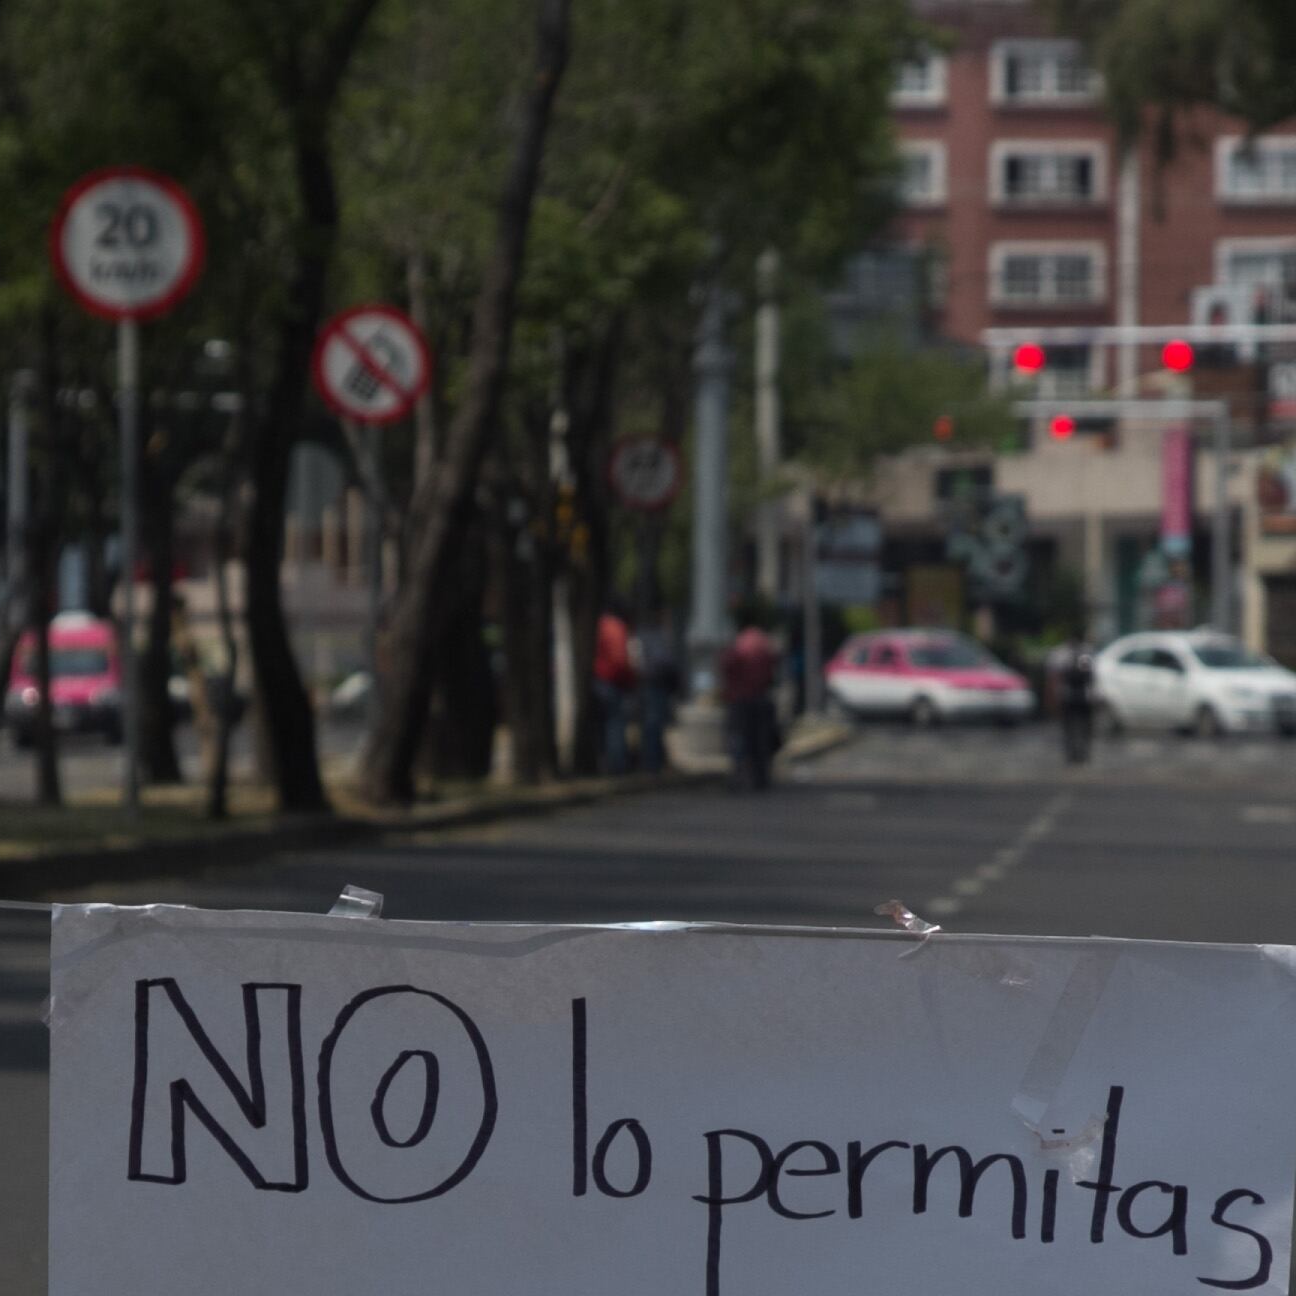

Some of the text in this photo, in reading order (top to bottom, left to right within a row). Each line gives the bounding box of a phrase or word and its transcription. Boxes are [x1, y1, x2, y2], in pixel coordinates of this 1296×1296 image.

[94, 202, 161, 249] 20
[127, 977, 498, 1204] NO
[572, 996, 652, 1197] lo
